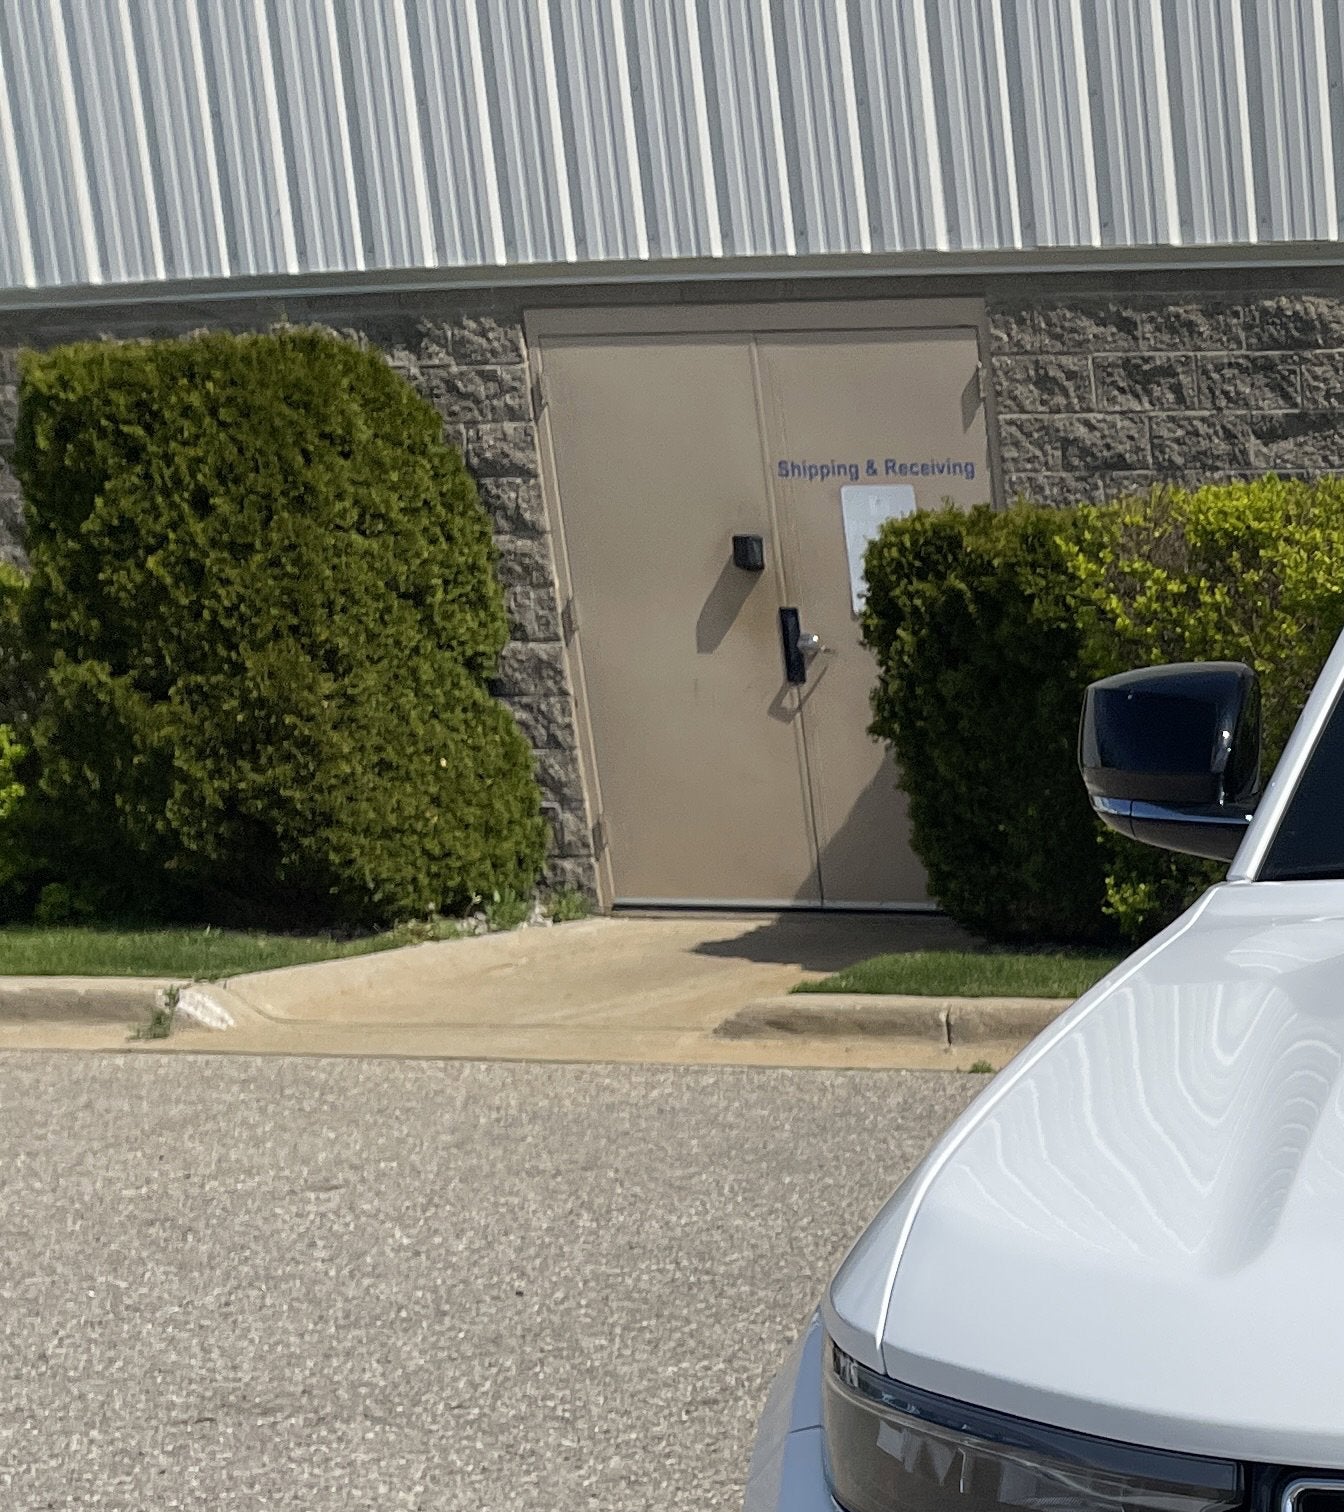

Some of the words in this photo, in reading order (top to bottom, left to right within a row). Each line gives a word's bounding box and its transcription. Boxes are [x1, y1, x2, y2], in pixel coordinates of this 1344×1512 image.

[778, 460, 860, 481] Shipping
[866, 459, 877, 476] &
[884, 458, 975, 480] Receiving
